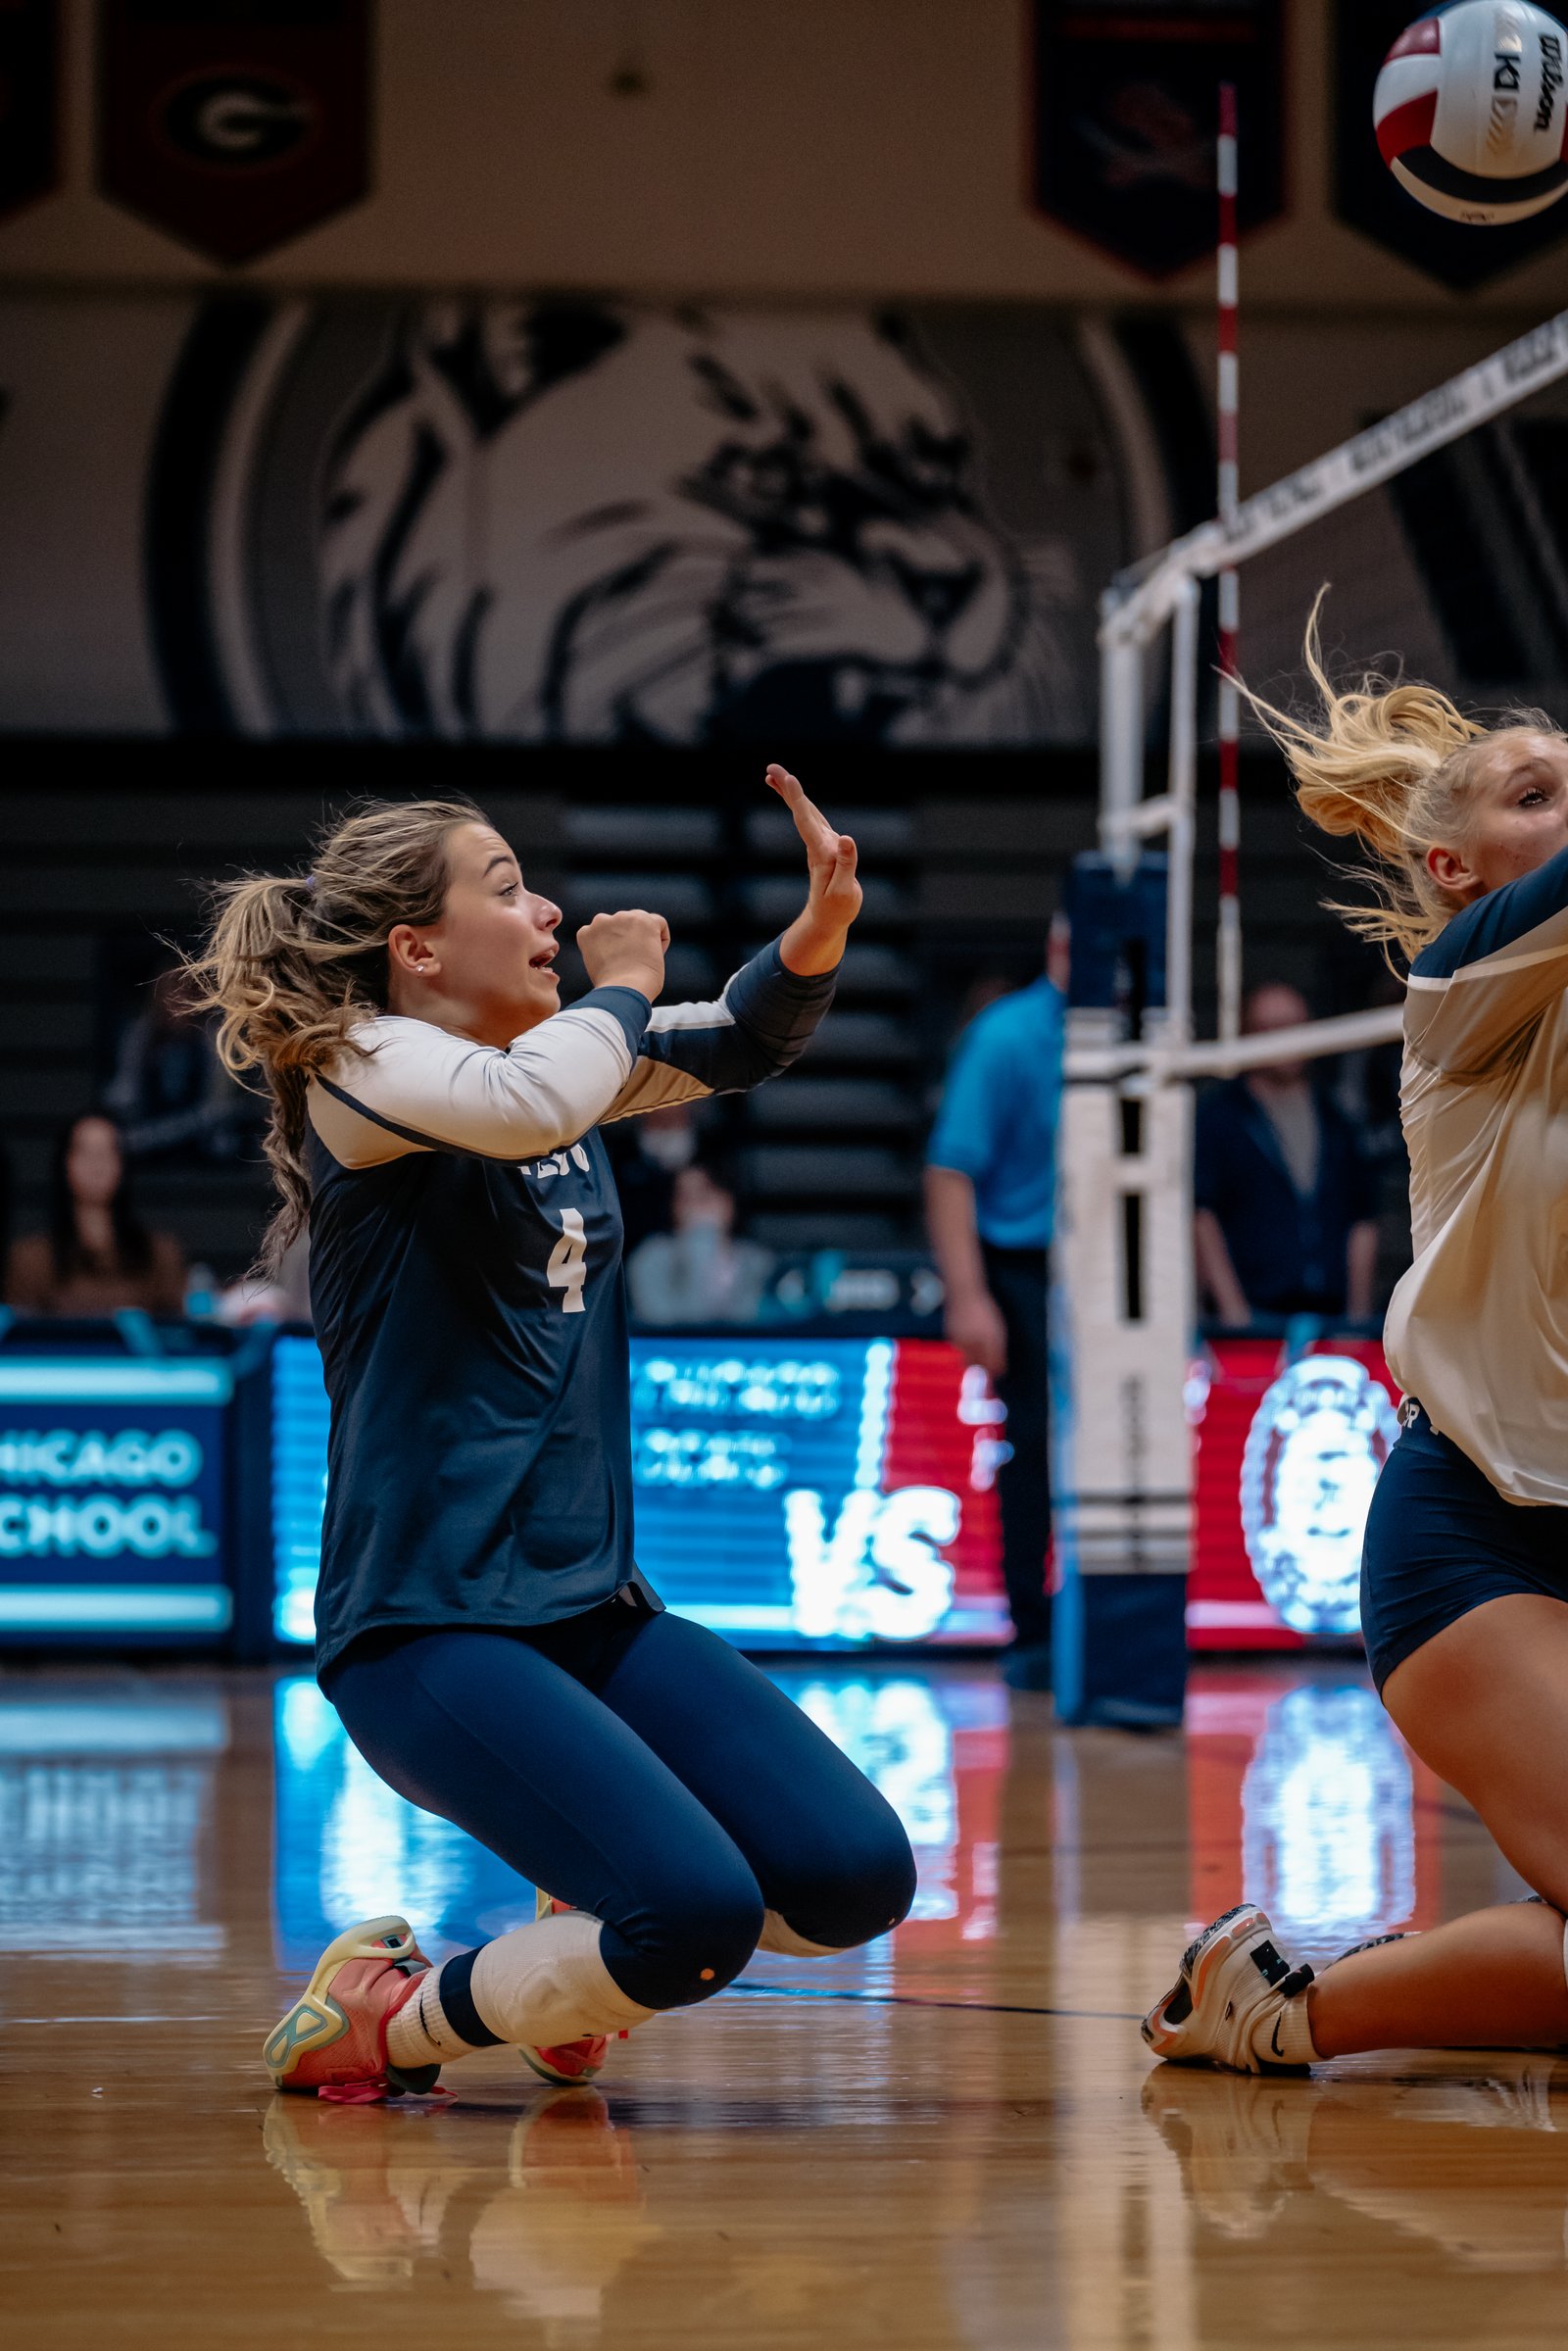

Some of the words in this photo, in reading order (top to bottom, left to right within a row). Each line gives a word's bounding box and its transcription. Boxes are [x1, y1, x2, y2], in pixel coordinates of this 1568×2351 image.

[1534, 32, 1564, 133] Wilson
[546, 1207, 587, 1313] 4
[786, 1489, 960, 1641] VS
